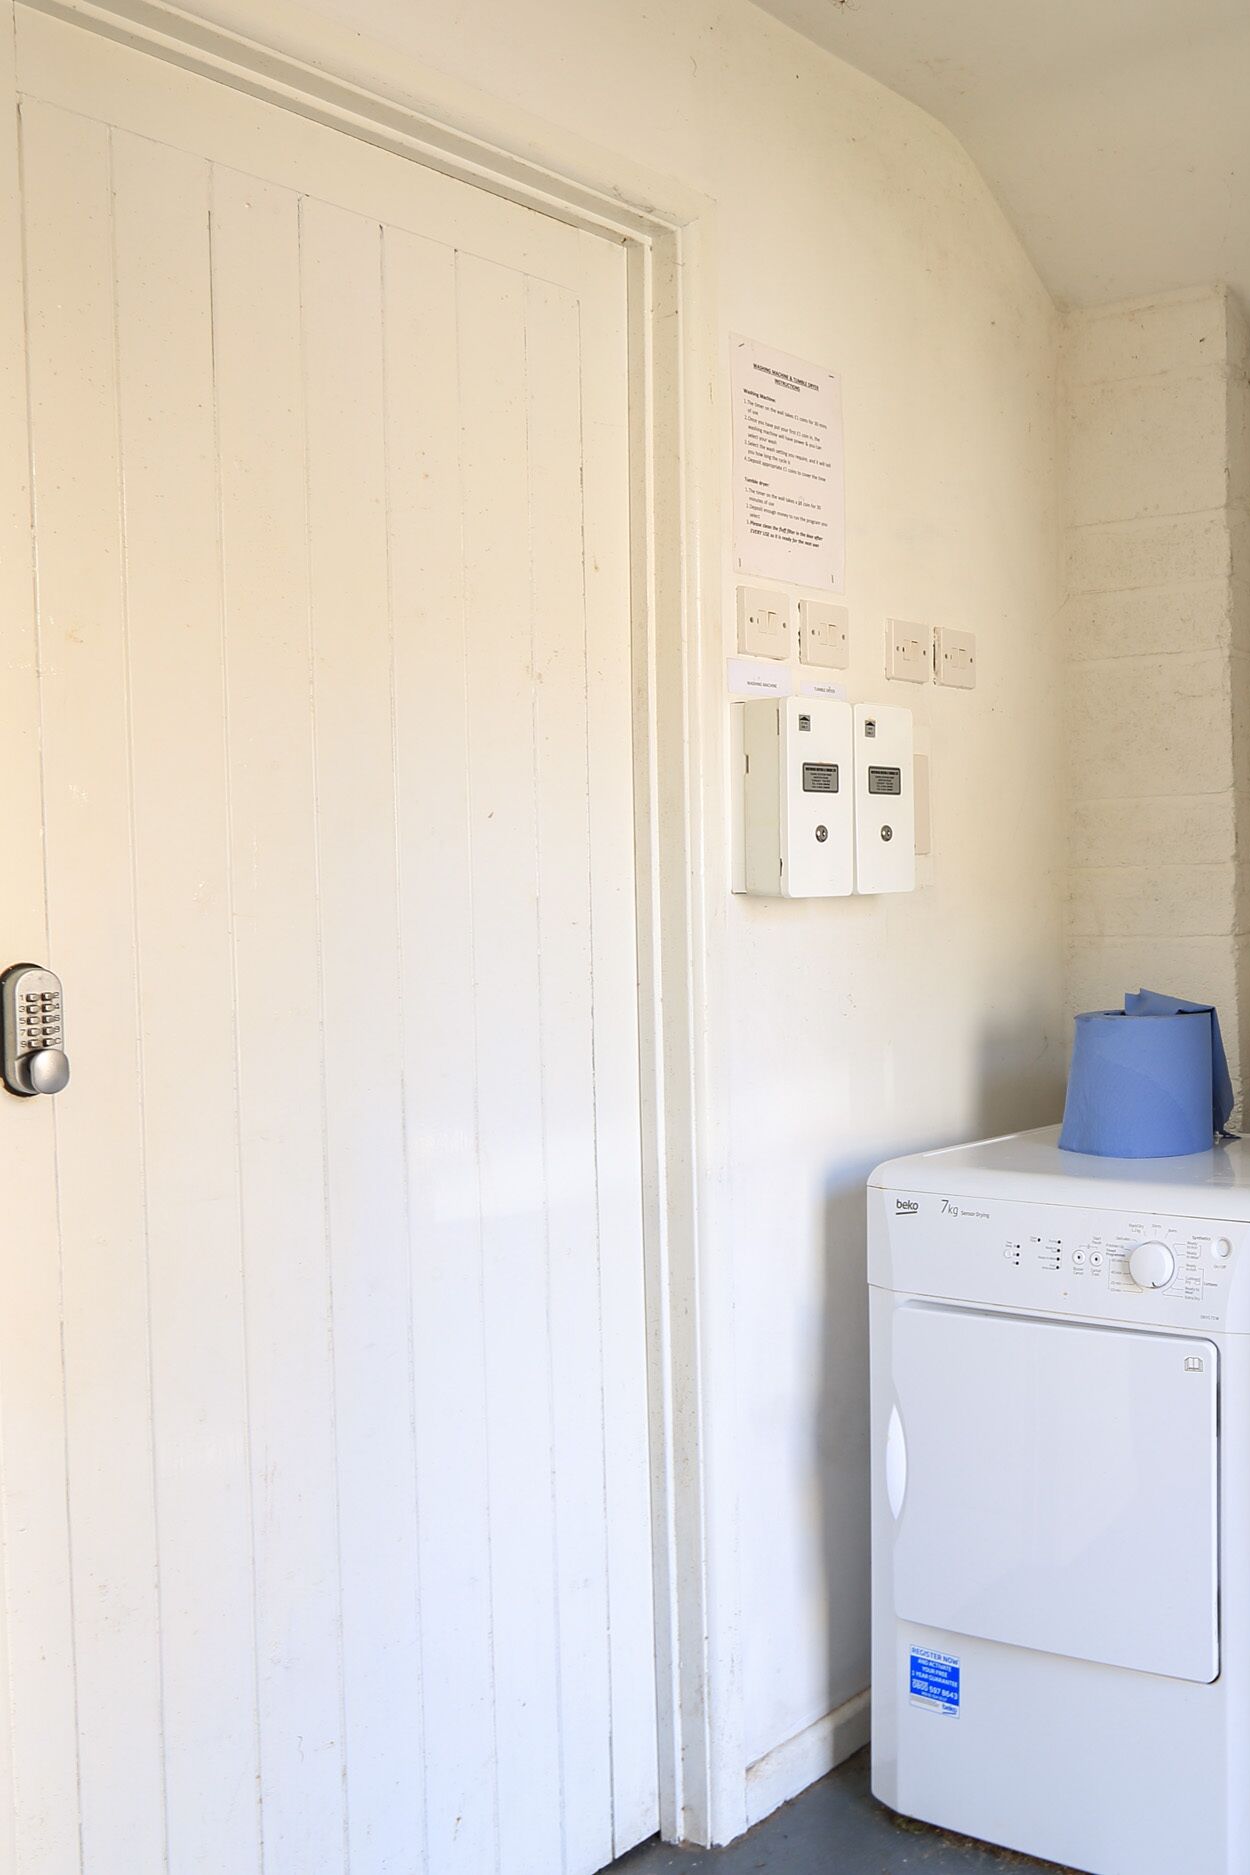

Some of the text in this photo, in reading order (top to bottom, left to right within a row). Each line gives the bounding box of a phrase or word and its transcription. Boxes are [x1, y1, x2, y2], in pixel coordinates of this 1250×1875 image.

[896, 1198, 958, 1218] beko 7kg
[912, 1647, 958, 1666] REGISTER NOW
